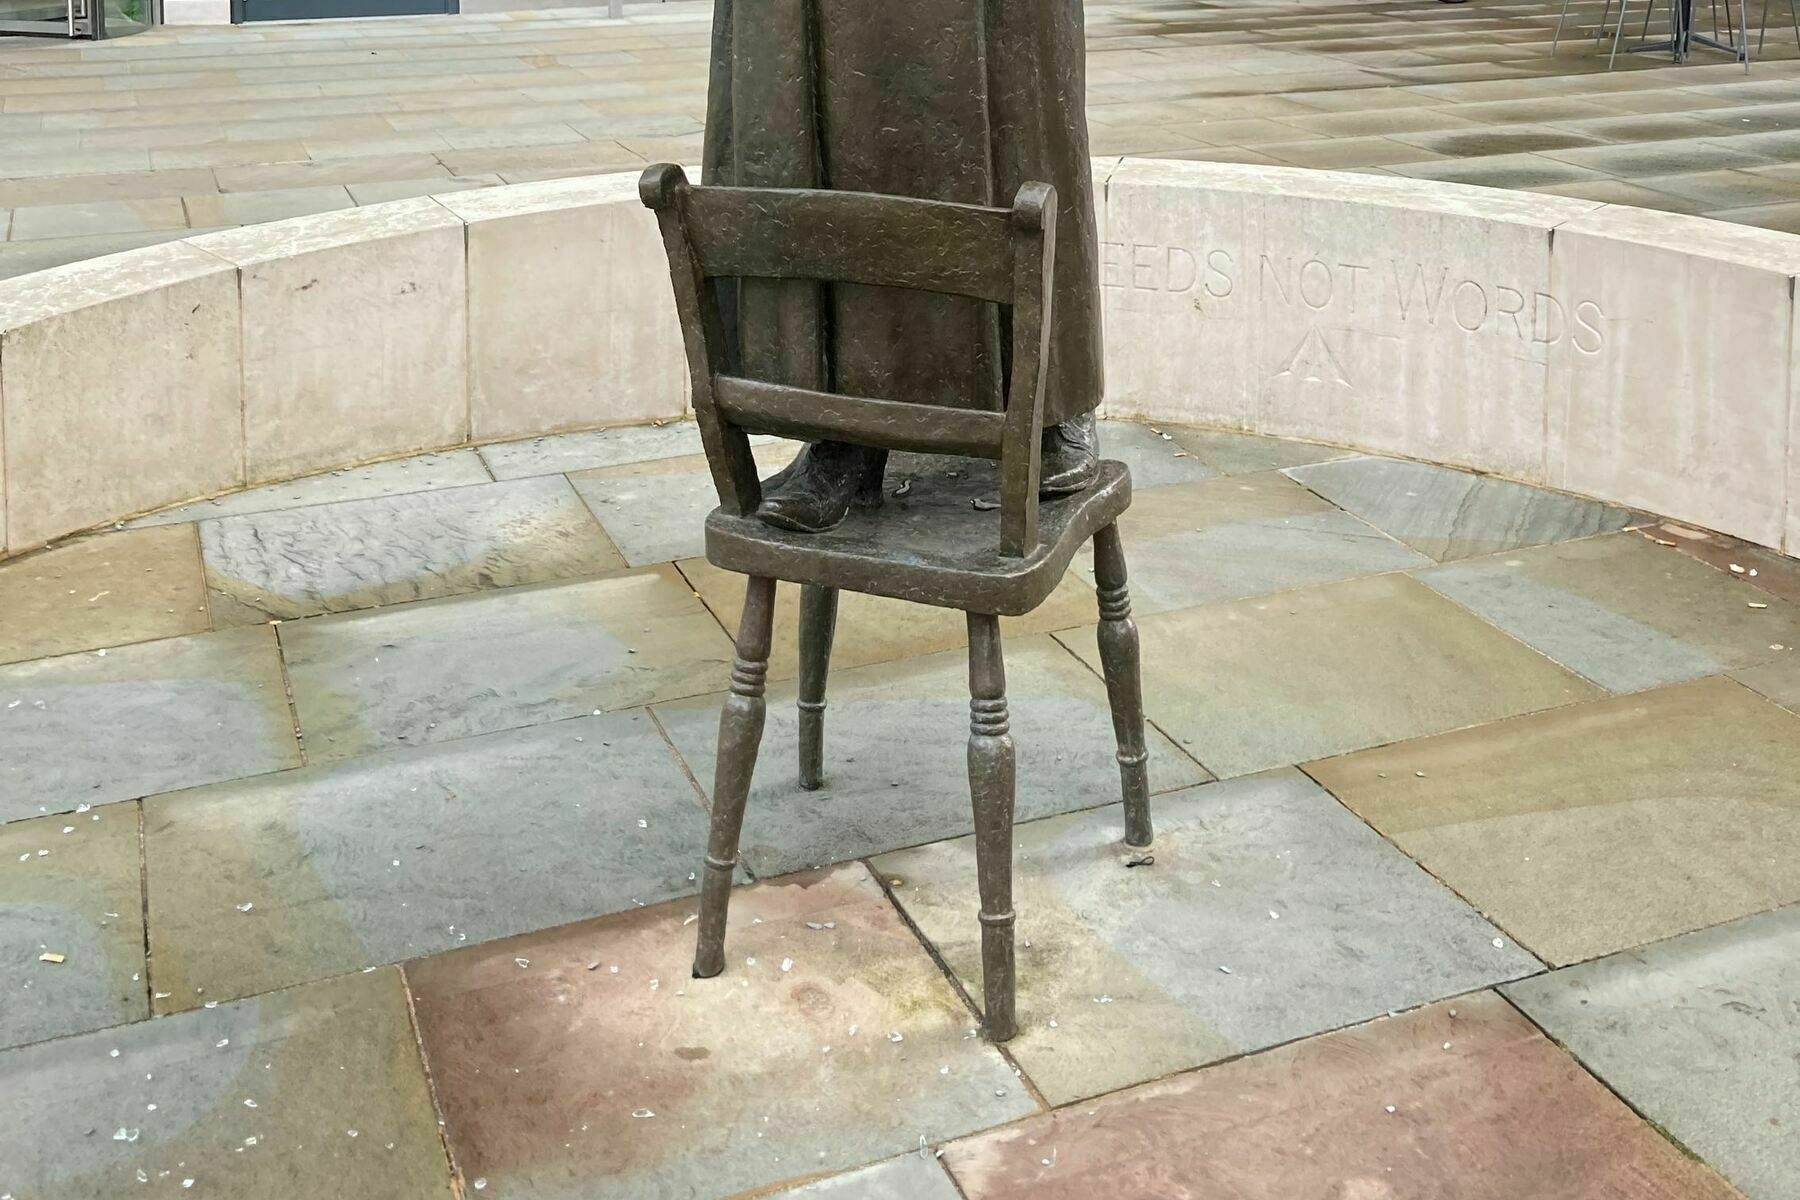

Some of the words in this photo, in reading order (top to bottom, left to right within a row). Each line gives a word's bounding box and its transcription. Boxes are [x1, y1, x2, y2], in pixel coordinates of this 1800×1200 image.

[1100, 241, 1233, 298] EEDS
[1258, 253, 1369, 314] NOT
[1390, 259, 1604, 355] WORDS
